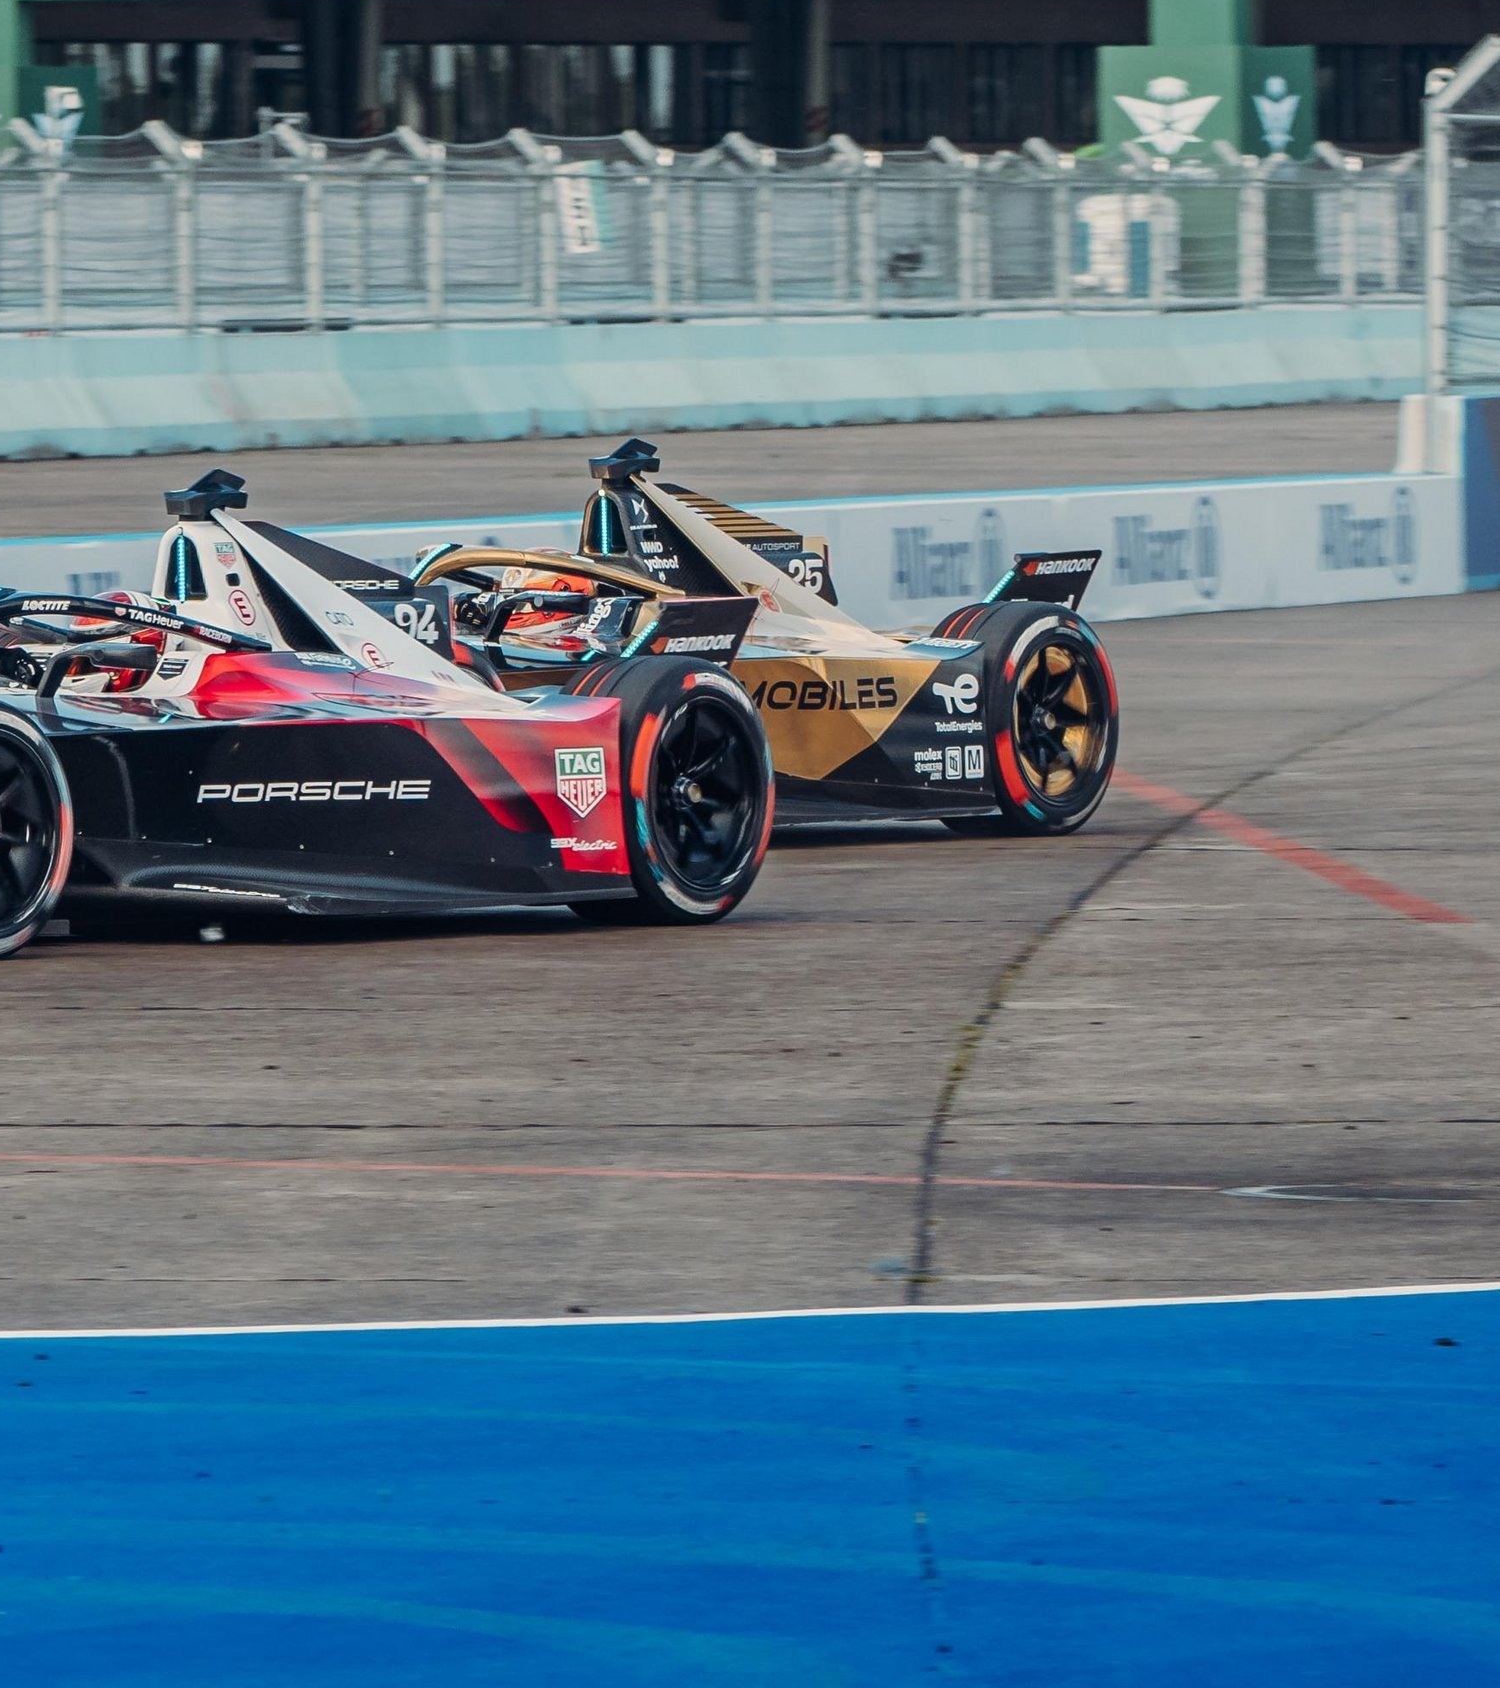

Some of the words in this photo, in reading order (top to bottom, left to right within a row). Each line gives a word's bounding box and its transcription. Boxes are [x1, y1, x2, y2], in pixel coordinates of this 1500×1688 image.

[751, 541, 801, 552] AUTOSPORT
[643, 555, 680, 572] yahoo!
[787, 558, 824, 595] 25
[21, 599, 71, 612] LOCTITE
[127, 608, 185, 630] TAGHeuer
[393, 603, 440, 645] 94
[934, 720, 984, 733] TotalEnergies
[559, 752, 601, 774] TAG
[914, 748, 943, 762] molex
[197, 779, 432, 803] PORSCHE
[560, 779, 604, 812] HEUER
